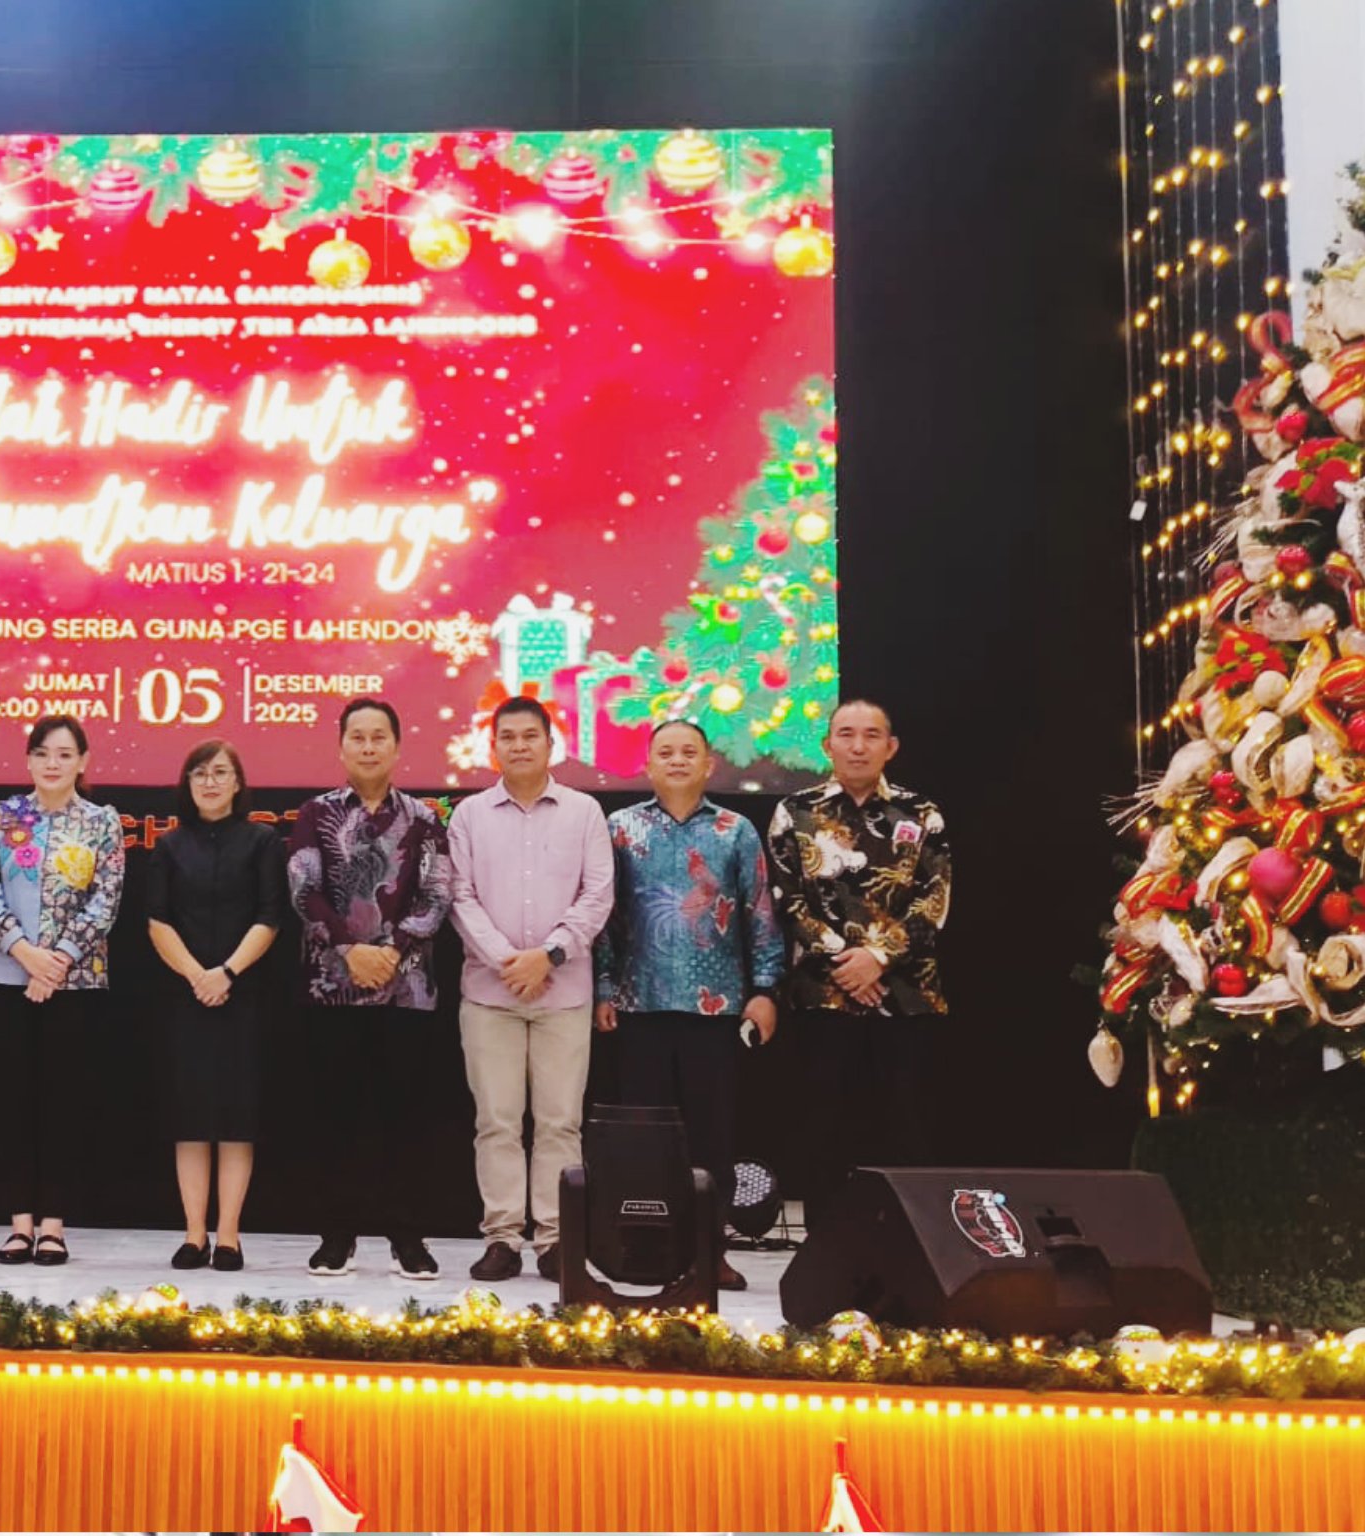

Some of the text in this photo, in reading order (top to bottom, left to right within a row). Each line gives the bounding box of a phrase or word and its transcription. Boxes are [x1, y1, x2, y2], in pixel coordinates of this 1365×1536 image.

[79, 378, 228, 447] Hadir
[238, 372, 414, 465] Untuk
[127, 562, 227, 585] MATIUS
[261, 562, 336, 585] 21-24
[51, 618, 138, 640] SERBA
[143, 618, 225, 640] GUNA
[233, 618, 288, 641] PGE
[22, 673, 110, 692] JUMAT
[254, 673, 383, 694] DESEMBER
[137, 667, 223, 725] 05
[43, 698, 109, 718] WITA
[254, 702, 318, 723] 2025
